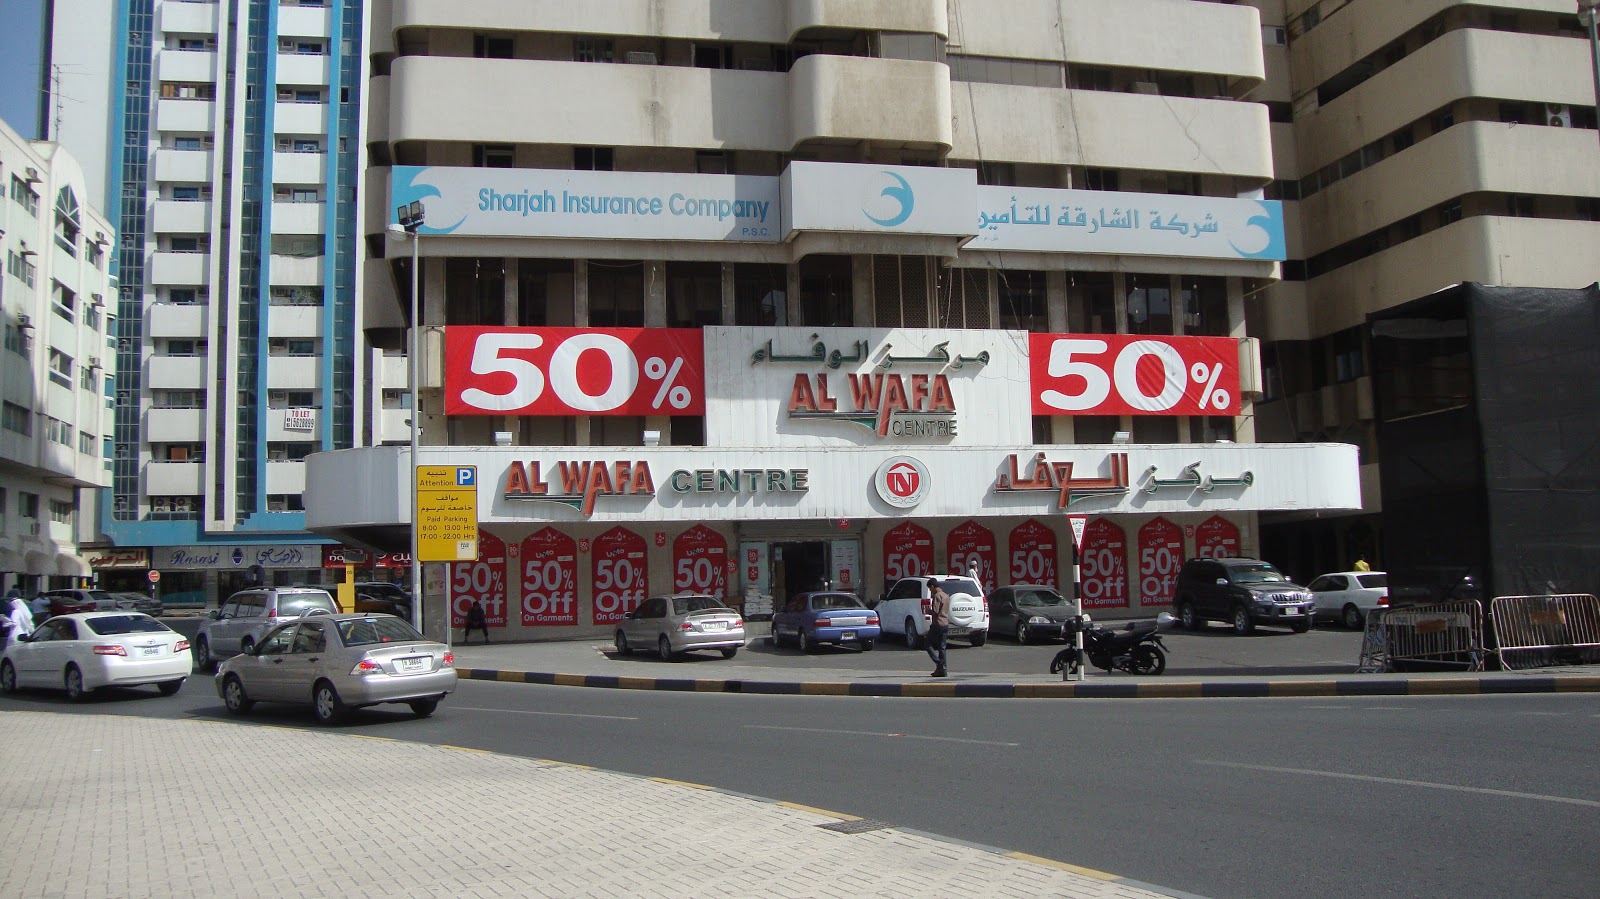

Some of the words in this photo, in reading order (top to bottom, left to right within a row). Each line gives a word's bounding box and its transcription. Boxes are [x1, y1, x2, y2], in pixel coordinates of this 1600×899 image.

[478, 188, 556, 217] Sharjah
[562, 190, 663, 215] Insurance
[668, 193, 770, 222] Company
[742, 227, 770, 236] P.S.C.
[1057, 206, 1140, 234] الشارقة
[1150, 211, 1218, 239] شركة
[751, 332, 869, 370] الوفاء
[876, 340, 990, 370] مركز
[460, 332, 692, 412] 50%
[1040, 339, 1231, 411] 50%
[787, 373, 838, 413] AL
[848, 373, 956, 437] WAFA
[892, 419, 958, 437] CENTRE
[459, 469, 471, 484] P
[505, 460, 548, 495] AL
[558, 460, 656, 516] WAFA
[671, 468, 811, 494] CENTRE
[995, 452, 1129, 509] الوفاء
[1141, 461, 1254, 494] مركز
[595, 559, 645, 589] 50%
[676, 558, 724, 588] 50%
[886, 553, 930, 579] 50%
[950, 552, 994, 579] 50%
[1011, 550, 1055, 579] 50%
[1082, 548, 1124, 576] 50%
[1141, 547, 1181, 575] 50%
[453, 562, 503, 593] 50%
[524, 560, 573, 591] 50%
[1083, 577, 1124, 597] Off
[453, 593, 503, 616] Off
[524, 591, 573, 614] Off
[595, 590, 645, 612] Off
[1094, 597, 1125, 605] Garments
[537, 614, 573, 622] Garments
